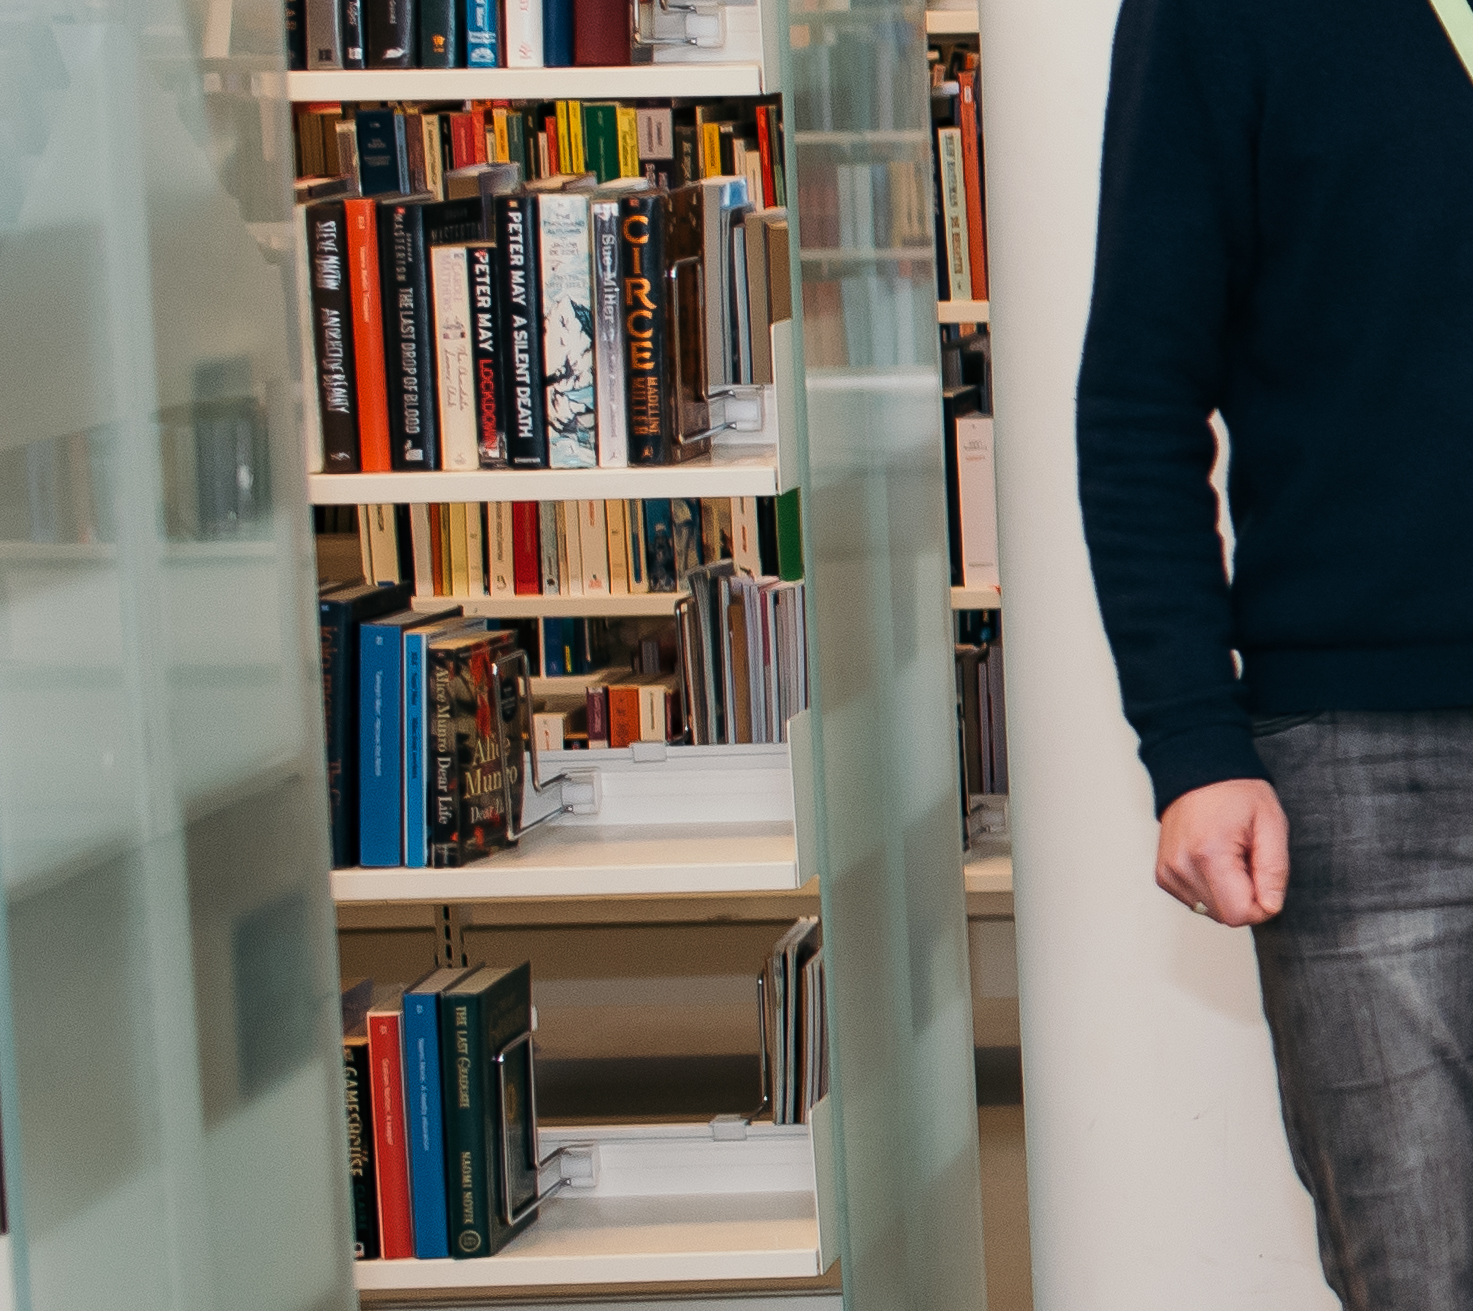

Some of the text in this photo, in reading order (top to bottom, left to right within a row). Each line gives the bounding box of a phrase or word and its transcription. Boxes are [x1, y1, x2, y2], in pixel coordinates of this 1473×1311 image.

[400, 288, 420, 434] THE LAST DROP OF BLOOD
[474, 251, 493, 352] PETER MAY
[508, 211, 533, 438] PETER MAY A SILENT DEATH
[622, 215, 658, 370] CIRCE
[435, 666, 453, 825] Alice Munro Dear Life
[456, 1030, 469, 1054] LAST
